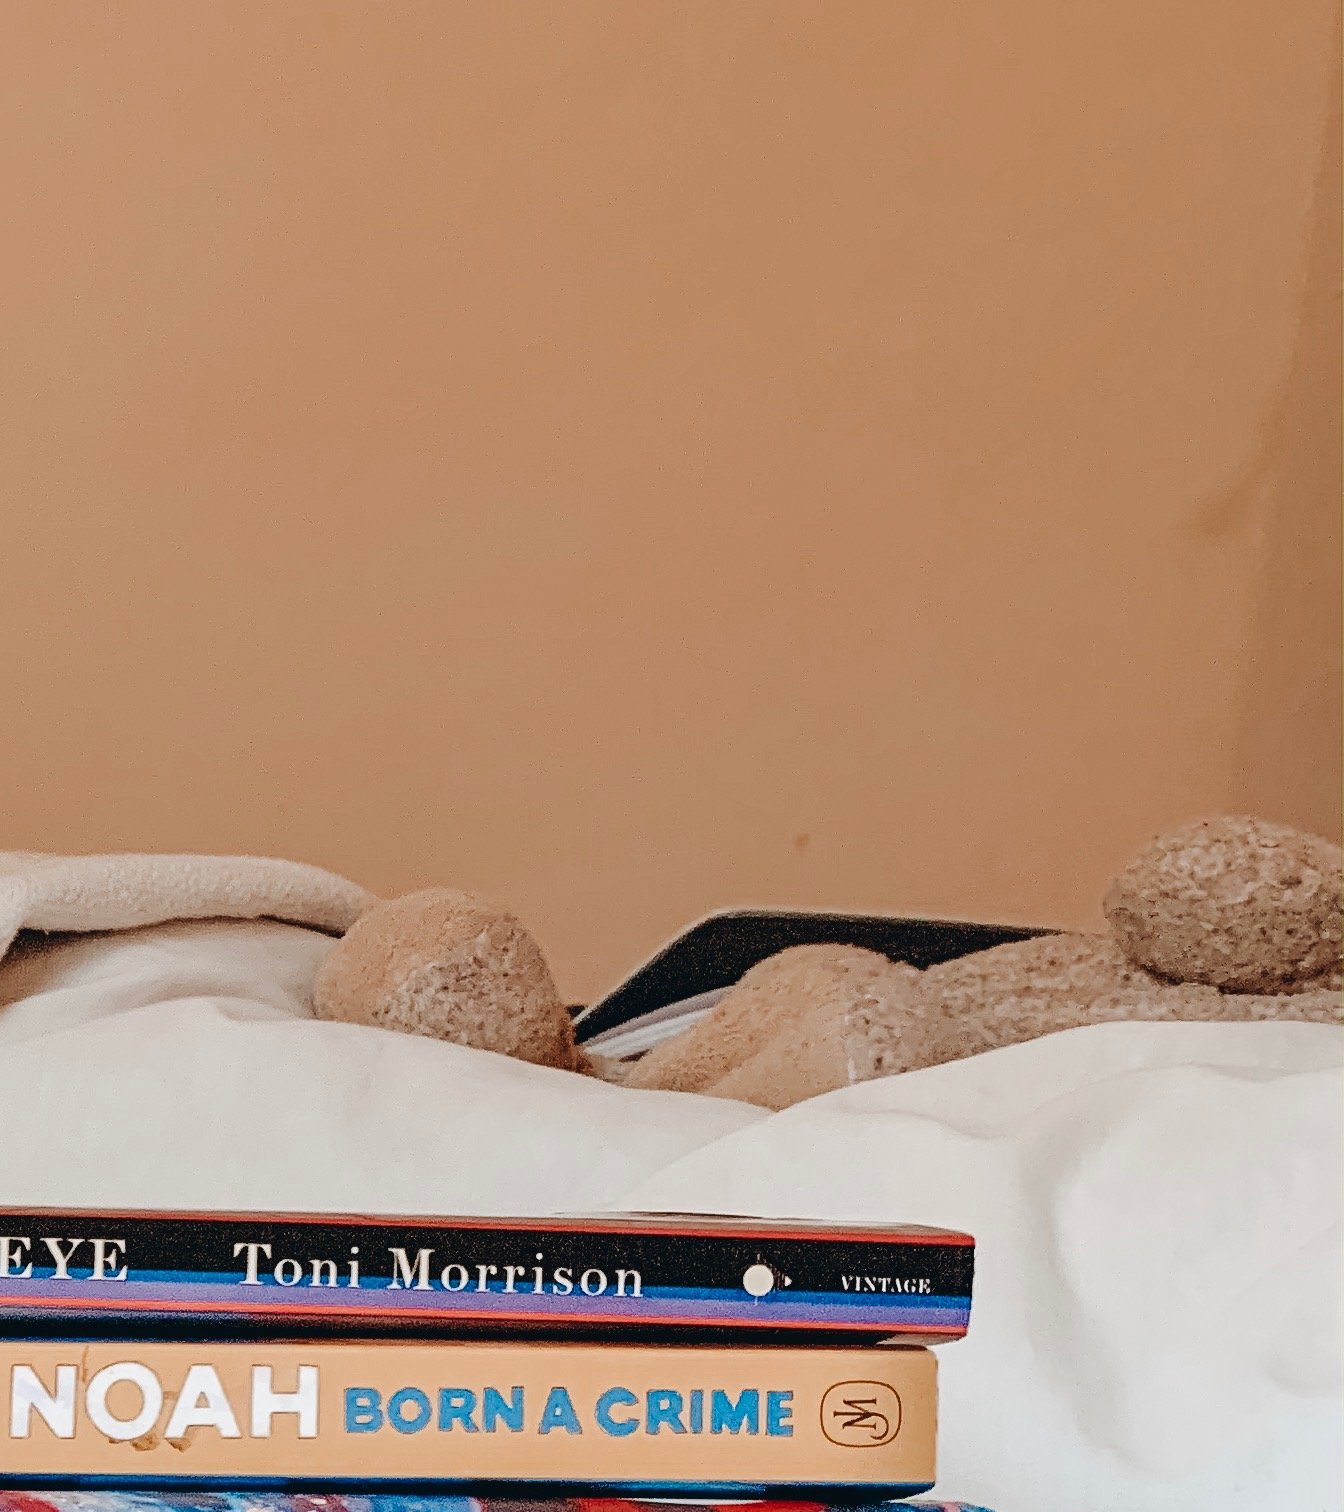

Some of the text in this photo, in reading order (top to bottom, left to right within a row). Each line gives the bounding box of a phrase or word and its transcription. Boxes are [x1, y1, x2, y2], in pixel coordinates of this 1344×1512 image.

[234, 1243, 644, 1299] Toni Morrison
[841, 1274, 931, 1294] VINTAGE
[10, 1364, 319, 1441] NOAH
[343, 1386, 523, 1435] BORN
[538, 1386, 583, 1436] A
[596, 1386, 794, 1438] CRIME
